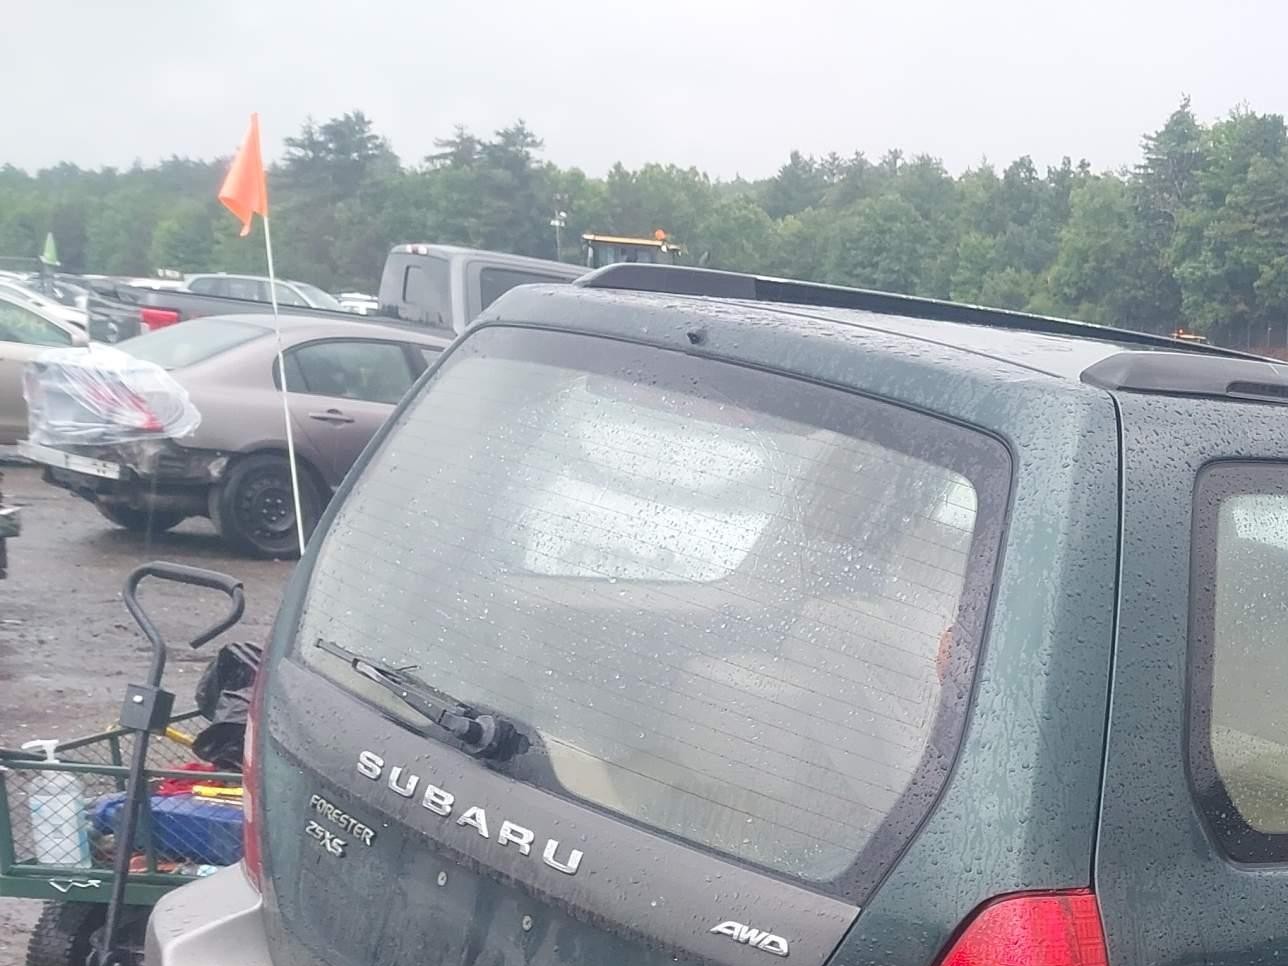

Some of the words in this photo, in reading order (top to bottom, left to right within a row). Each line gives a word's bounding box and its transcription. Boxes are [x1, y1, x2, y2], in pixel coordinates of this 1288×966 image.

[309, 794, 376, 847] FORESTER
[356, 750, 584, 875] SUBARU
[709, 920, 789, 957] AWD
